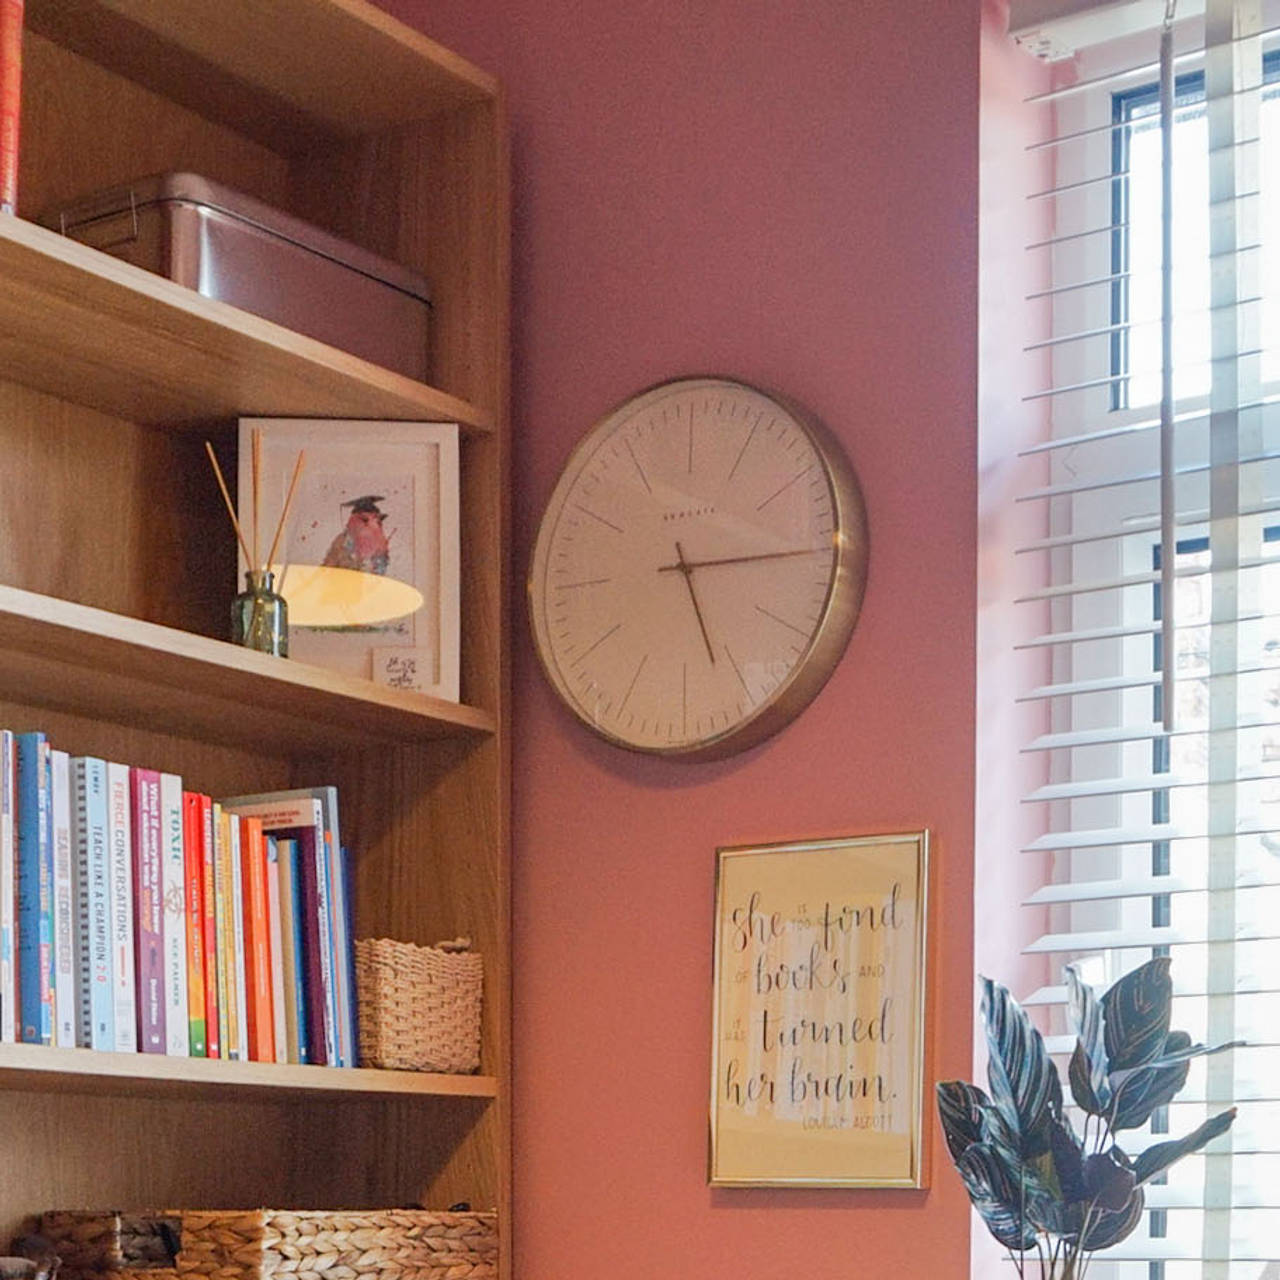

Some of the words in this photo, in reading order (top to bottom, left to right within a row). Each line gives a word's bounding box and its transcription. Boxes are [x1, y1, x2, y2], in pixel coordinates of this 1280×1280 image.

[113, 782, 127, 829] FIERCE
[93, 826, 105, 861] TEACH
[170, 809, 181, 864] TOXIC
[94, 863, 105, 888] LIKE
[94, 892, 105, 900] A
[115, 829, 128, 942] CONVERSATIONS
[94, 905, 106, 961] CHAMPION
[732, 891, 786, 953] she
[815, 883, 908, 953] fond
[756, 942, 851, 995] books
[858, 964, 886, 978] AND
[752, 997, 894, 1053] turned
[725, 1056, 776, 1109] her
